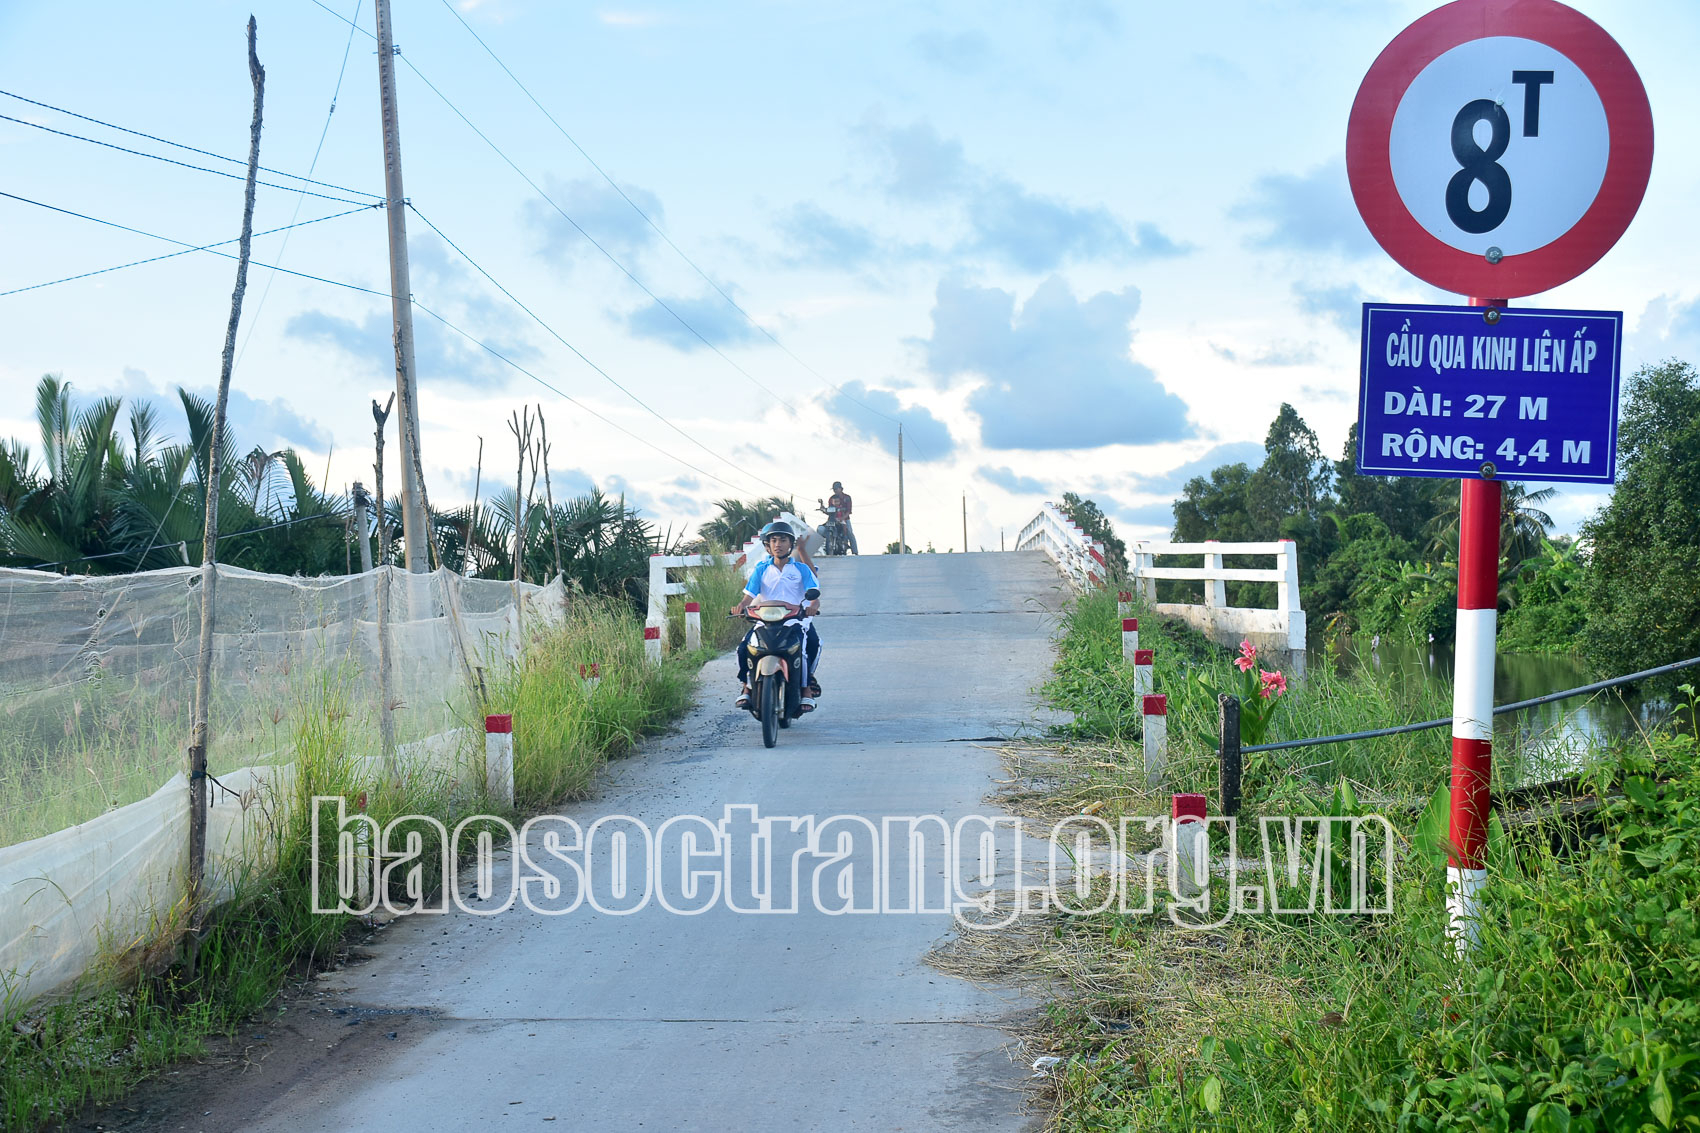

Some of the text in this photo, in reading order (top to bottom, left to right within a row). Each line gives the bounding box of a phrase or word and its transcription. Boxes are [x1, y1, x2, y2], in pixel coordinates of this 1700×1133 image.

[1386, 318, 1597, 375] CẦU QUA KINH LIÊN ẤP
[1383, 385, 1548, 421] DÀI: 27 M
[1381, 427, 1592, 467] RỘNG: 4,4 M
